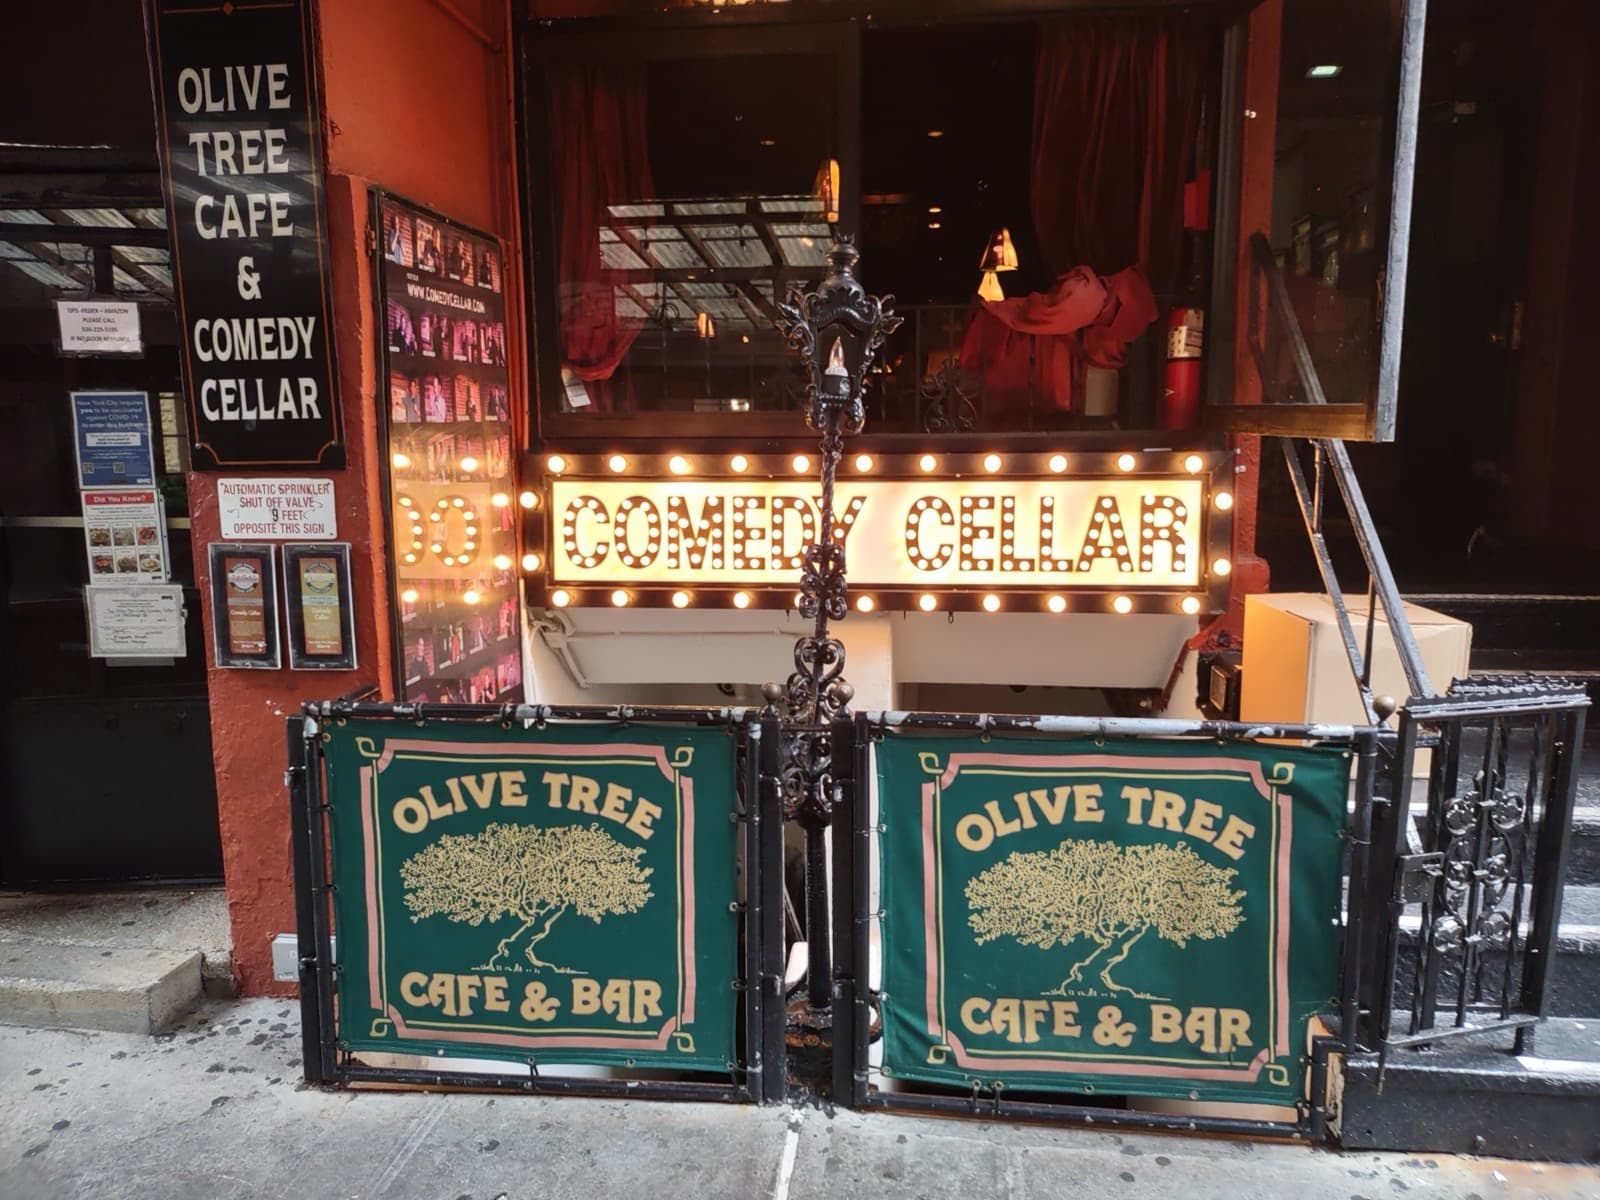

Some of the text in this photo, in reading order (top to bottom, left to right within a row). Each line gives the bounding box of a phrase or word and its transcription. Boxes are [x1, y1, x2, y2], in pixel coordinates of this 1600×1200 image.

[177, 63, 291, 114] OLIVE
[188, 128, 289, 176] TREE
[194, 192, 293, 240] CAFE
[237, 256, 262, 300] &
[407, 282, 486, 314] WWW.COMEDYCELLAR.COM
[194, 316, 316, 362] COMEDY
[201, 377, 322, 422] CELLAR
[93, 495, 106, 504] Did
[107, 495, 121, 503] You
[223, 483, 330, 495] AUTOMATIC SPRINKLER
[239, 496, 315, 508] SHUT OFF VALVE
[233, 523, 325, 534] OPPOSITE THIS SIGN
[271, 508, 304, 522] 9 FEET
[563, 495, 1188, 573] COMEDY CELLAR
[393, 769, 662, 840] OLIVE TREE
[956, 784, 1256, 860] OLIVE TREE
[400, 972, 663, 1023] CAFE & BAR
[960, 998, 1253, 1053] CAFE & BAR
